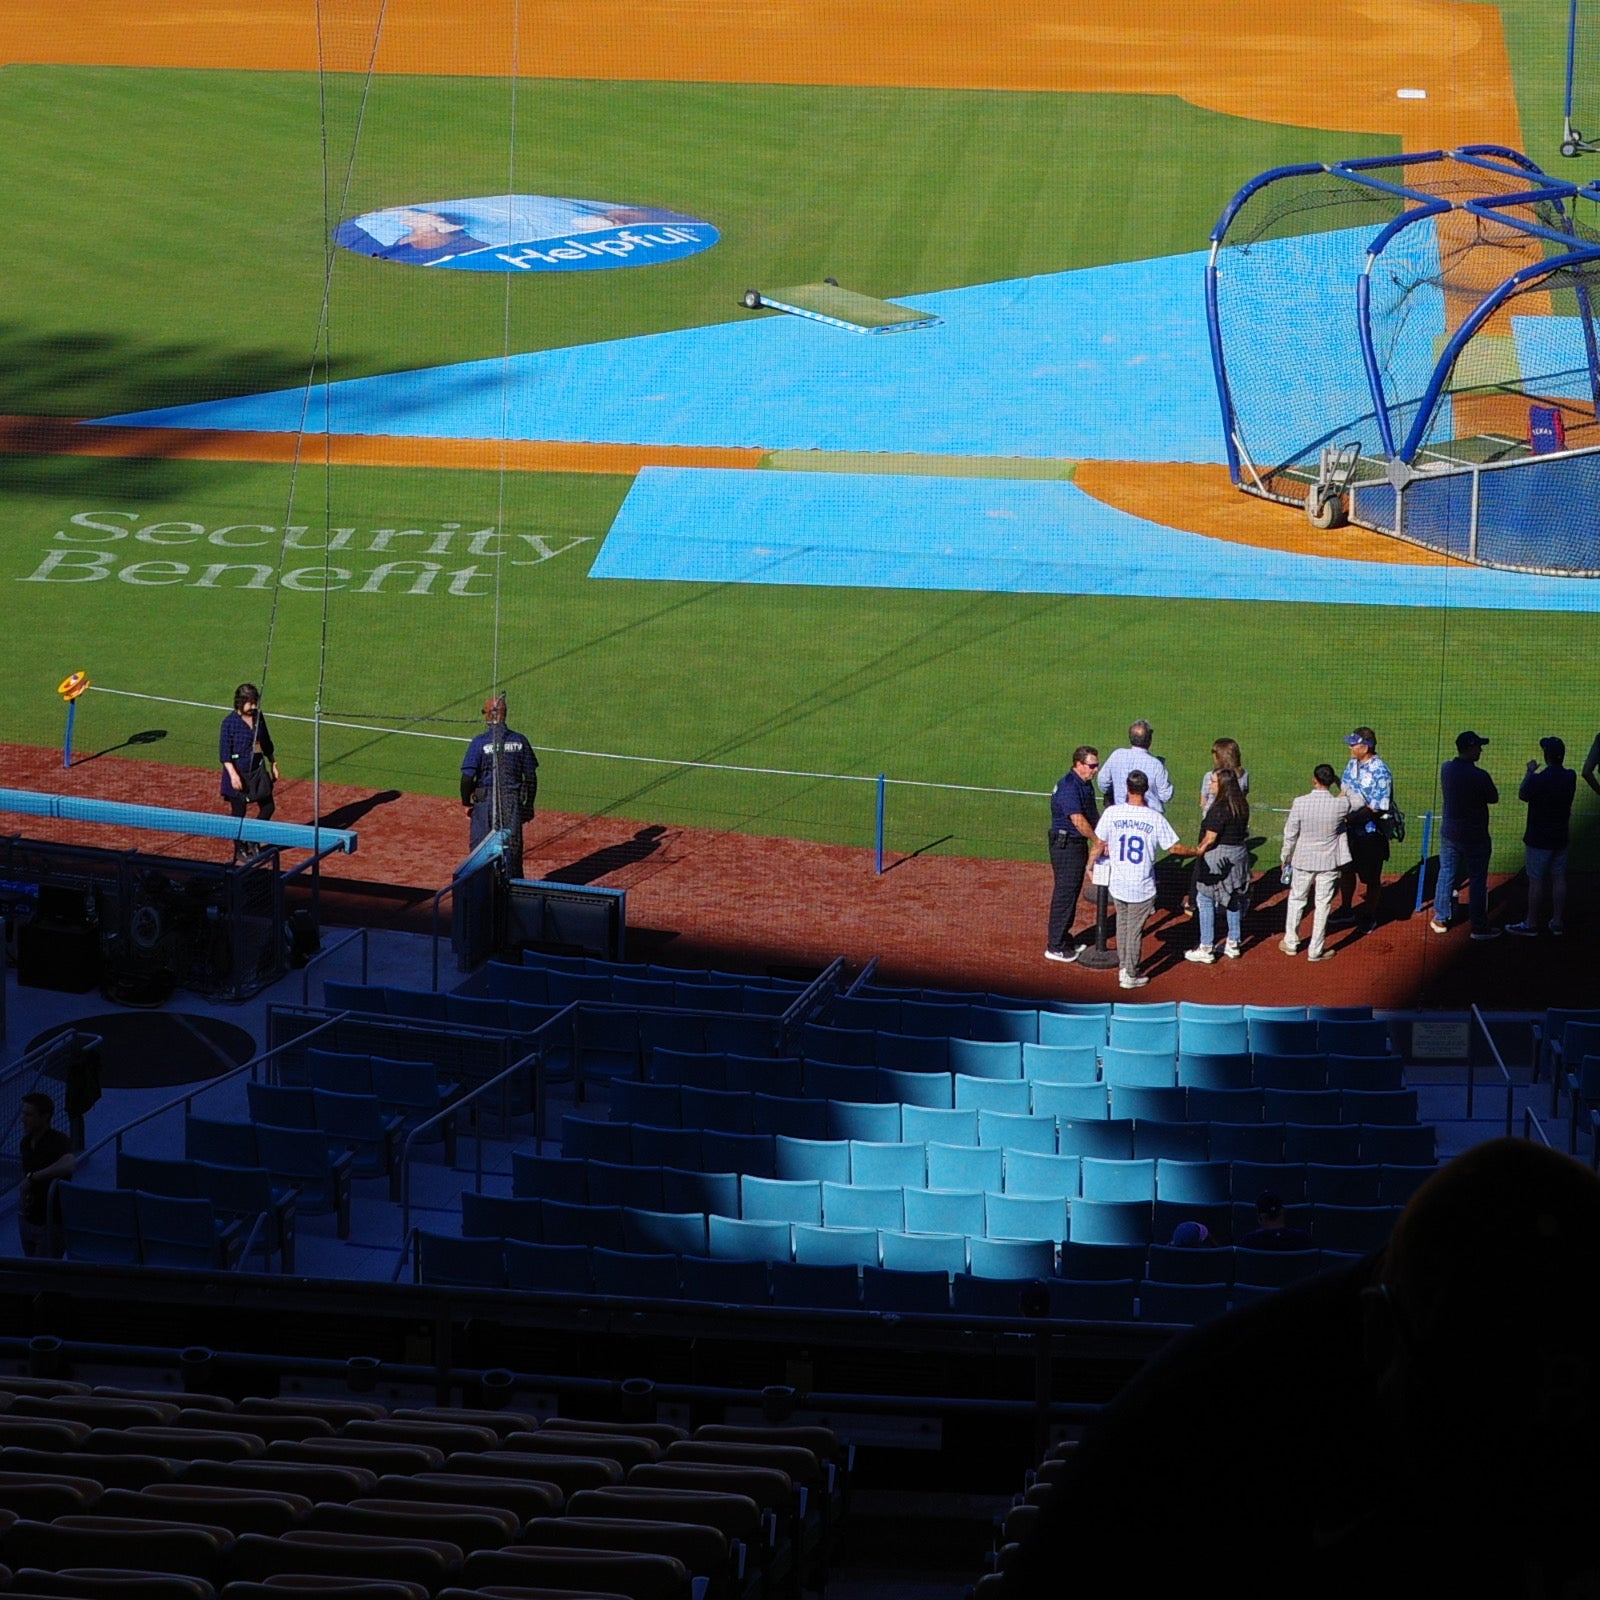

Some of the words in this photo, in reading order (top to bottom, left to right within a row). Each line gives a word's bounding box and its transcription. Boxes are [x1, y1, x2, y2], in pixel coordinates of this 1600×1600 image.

[498, 226, 702, 269] Helpful
[54, 509, 596, 567] Security
[15, 548, 492, 597] Benefit
[1113, 819, 1155, 835] YAMAMOTO
[1118, 833, 1145, 865] 18
